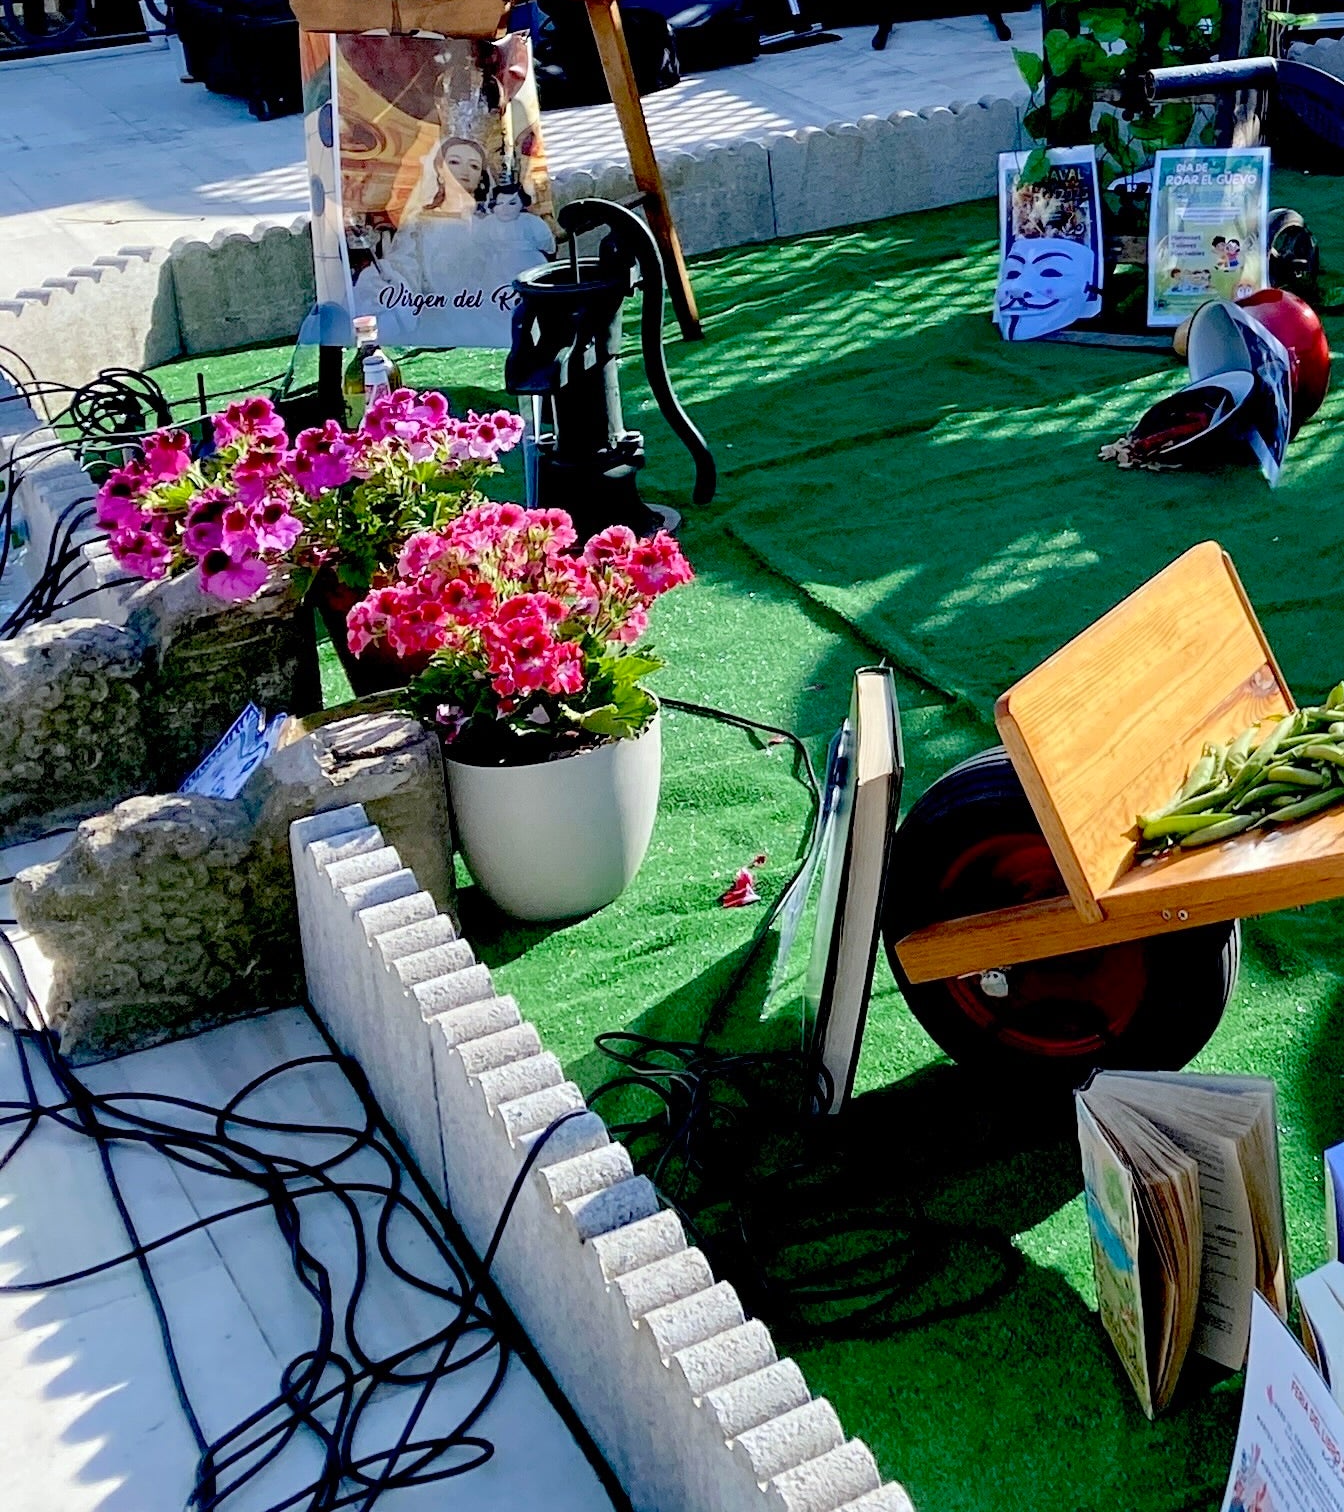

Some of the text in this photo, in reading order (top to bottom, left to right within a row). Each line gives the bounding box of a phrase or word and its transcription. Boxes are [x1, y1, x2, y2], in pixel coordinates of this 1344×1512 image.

[1176, 162, 1208, 173] DÍA DE
[1201, 175, 1213, 186] EL
[1216, 171, 1257, 185] GÜEVO
[379, 283, 448, 316] Virgen
[453, 288, 483, 308] del
